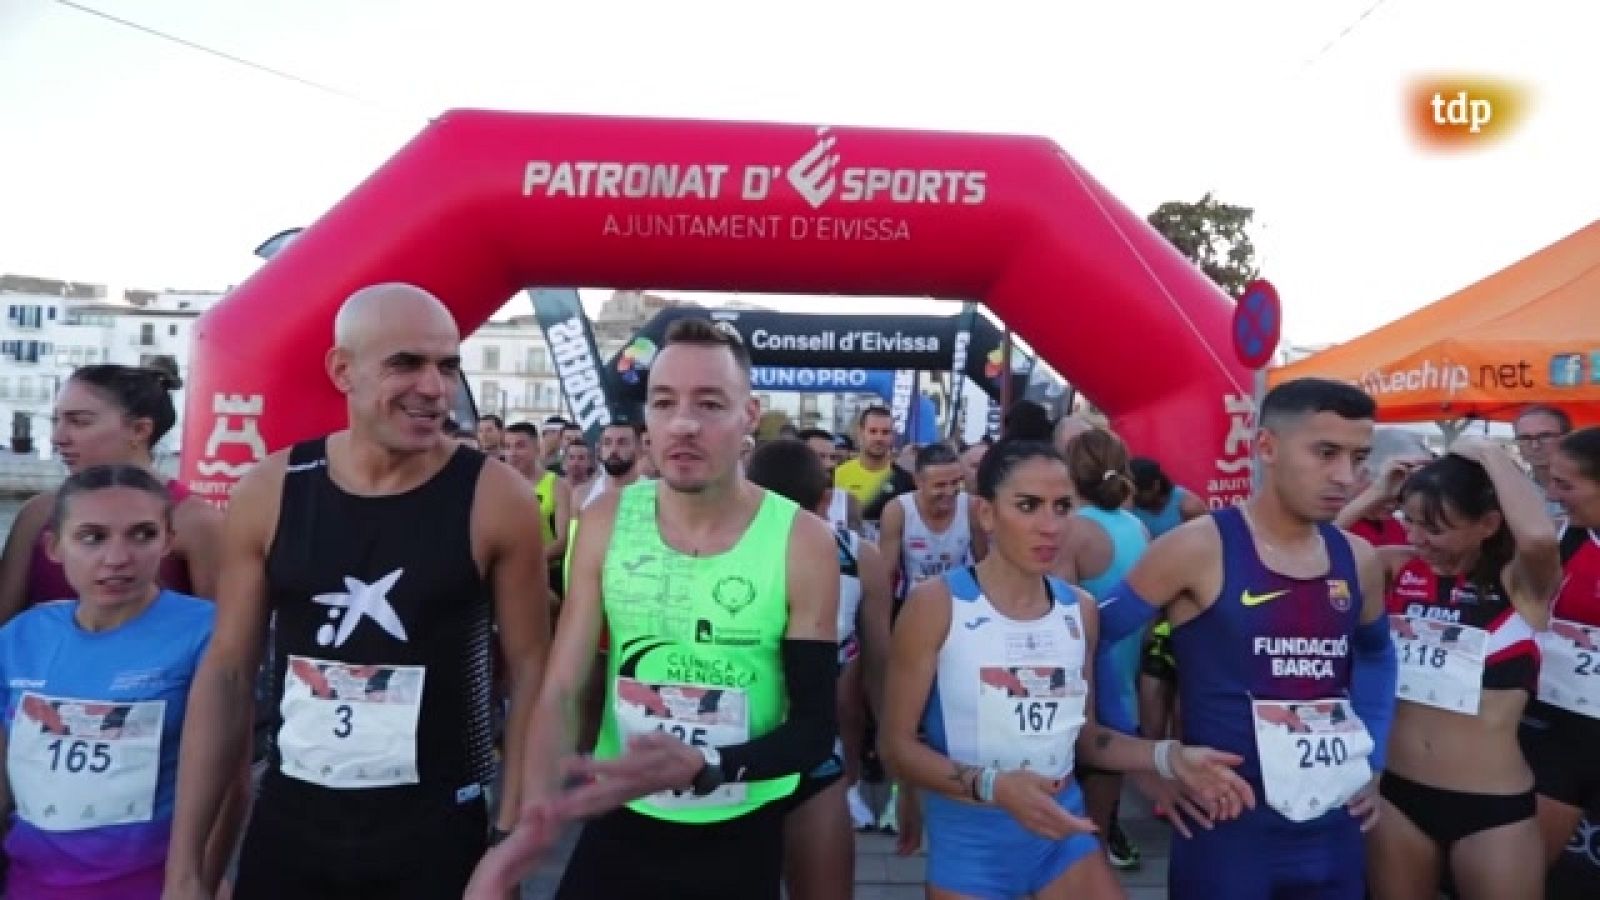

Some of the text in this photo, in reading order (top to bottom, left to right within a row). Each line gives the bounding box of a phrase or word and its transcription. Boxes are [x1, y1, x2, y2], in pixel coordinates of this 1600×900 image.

[522, 159, 729, 199] PATRONAT
[602, 213, 911, 241] AJUNTAMENT D'EIVISSA
[752, 328, 940, 352] Consell d'Eivissa
[1271, 657, 1335, 680] BARÇA
[1402, 643, 1448, 669] 118
[332, 704, 353, 738] 3
[1014, 702, 1059, 732] 167
[48, 740, 111, 773] 165
[1297, 737, 1348, 769] 240
